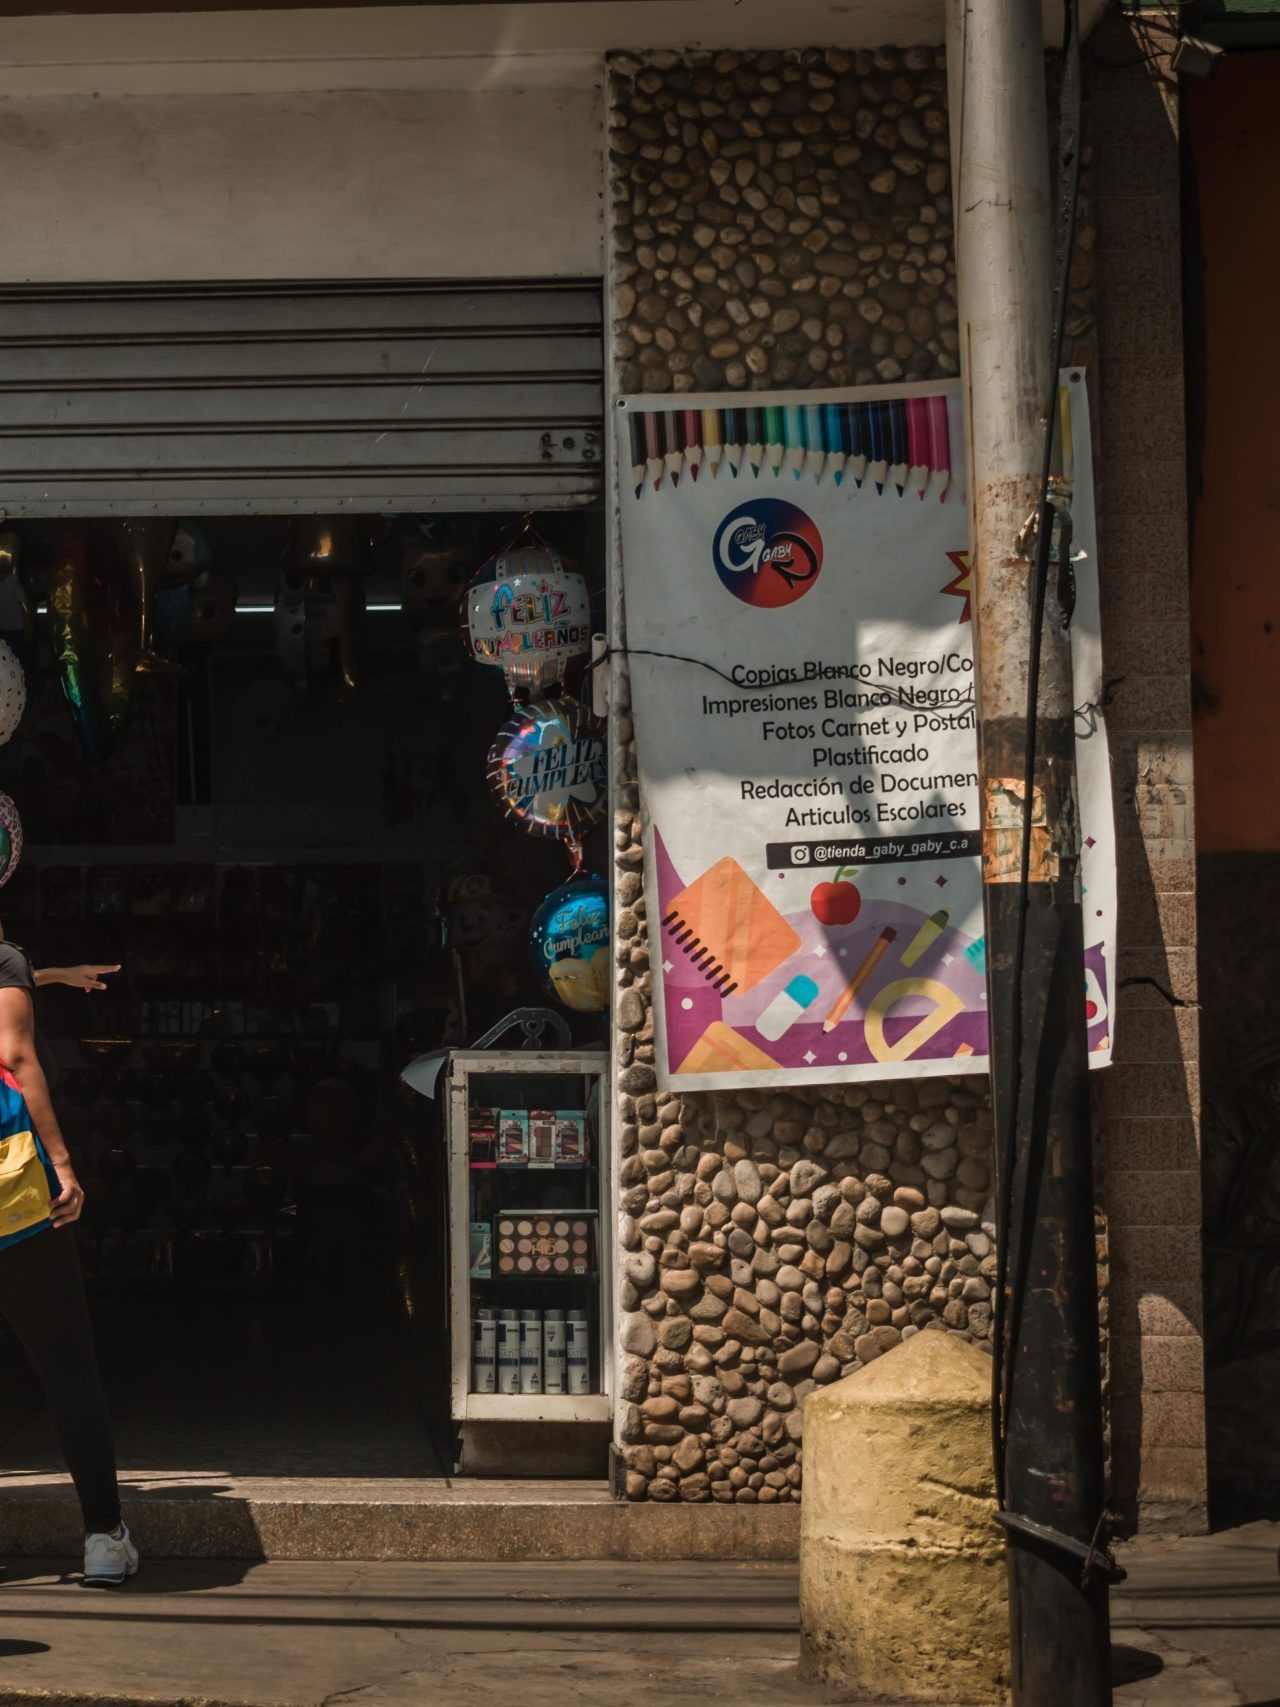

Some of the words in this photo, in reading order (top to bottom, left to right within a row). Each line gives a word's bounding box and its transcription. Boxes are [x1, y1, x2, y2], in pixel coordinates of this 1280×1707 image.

[762, 543, 792, 562] GABY
[473, 620, 589, 656] CUMPLEAÑOS
[731, 664, 797, 687] Copias
[803, 660, 871, 680] Blanco
[702, 692, 818, 717] Impresiones
[824, 688, 892, 709] Blanco
[898, 685, 961, 706] Negro
[762, 719, 815, 740] Fotos
[821, 717, 890, 738] Carnet
[895, 719, 908, 738] y
[533, 739, 596, 774] FELIZ
[813, 744, 929, 767] Plastificado
[740, 776, 843, 800] Redacción
[849, 775, 875, 795] de
[785, 804, 871, 827] Articulos
[877, 801, 967, 822] Escolares
[814, 837, 969, 861] @tienda_gaby_gaby_c.a
[557, 905, 600, 934] Feliz
